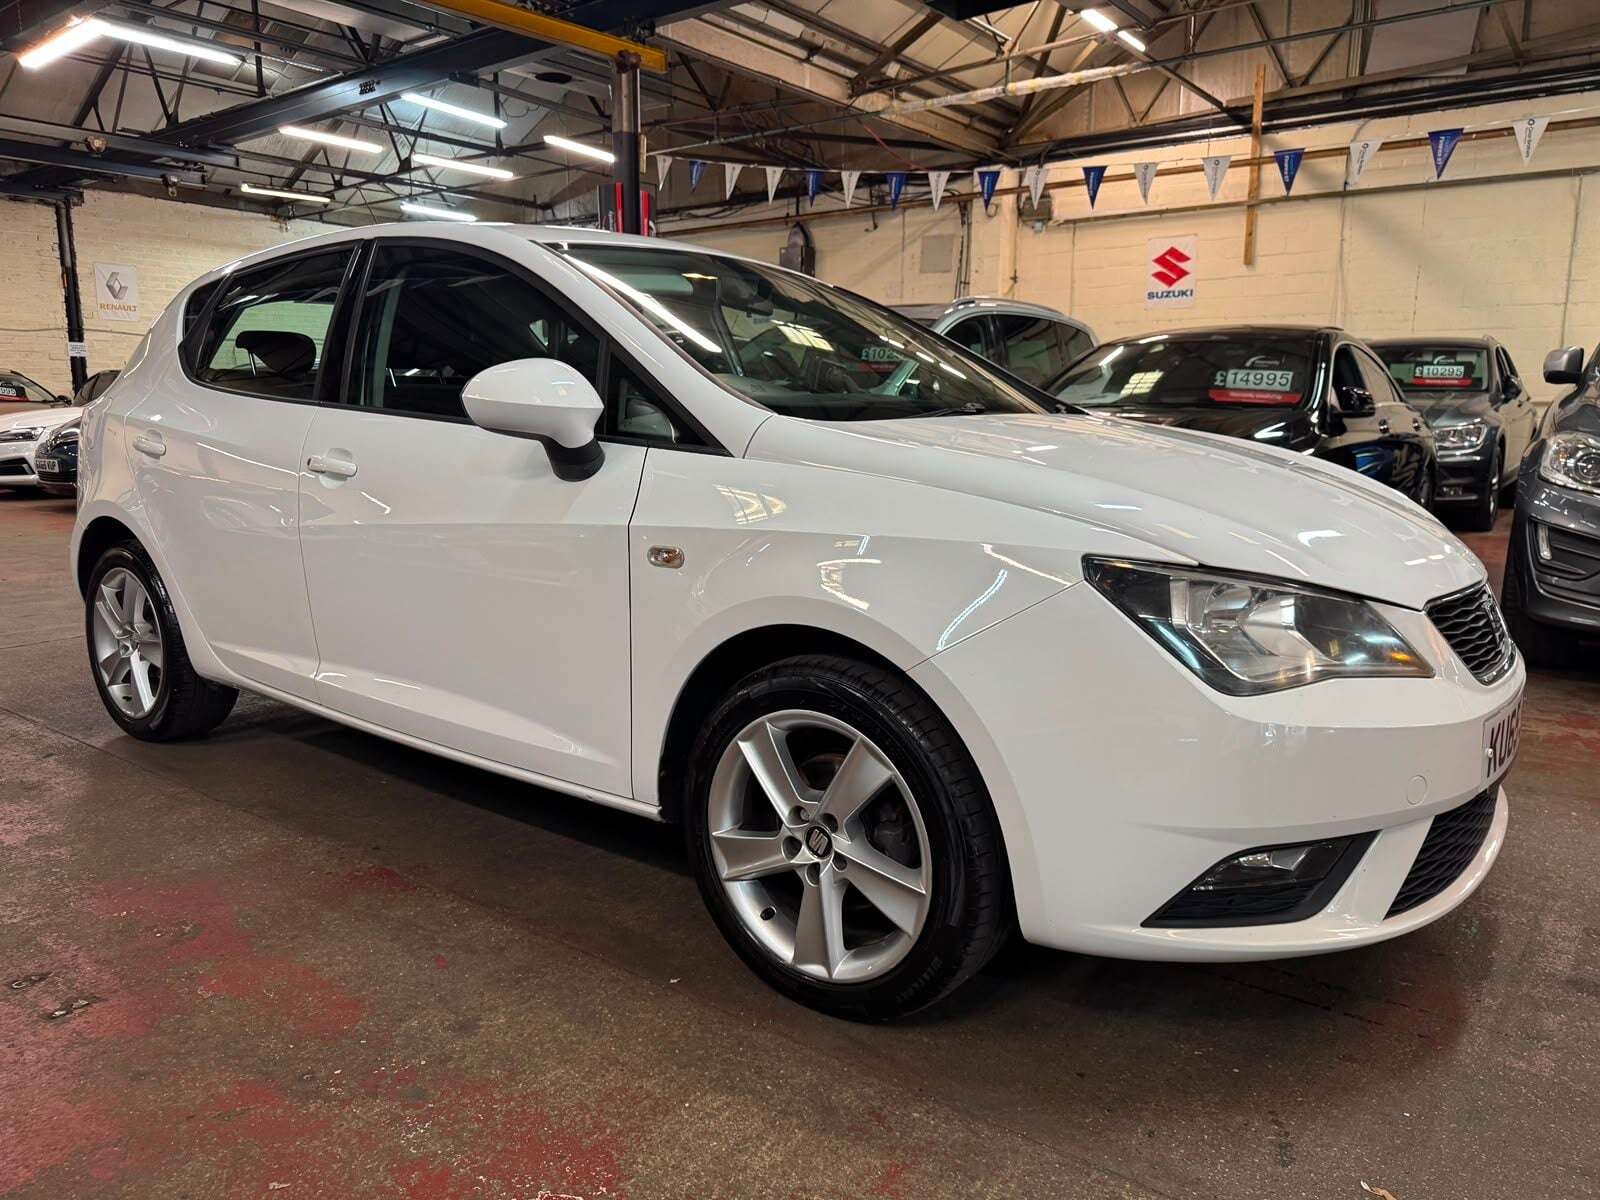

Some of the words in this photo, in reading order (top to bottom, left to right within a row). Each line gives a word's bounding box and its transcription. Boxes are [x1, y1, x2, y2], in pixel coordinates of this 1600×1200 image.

[1147, 289, 1194, 300] SUZUKI
[100, 303, 137, 311] RENAULT
[1213, 371, 1291, 387] £14995
